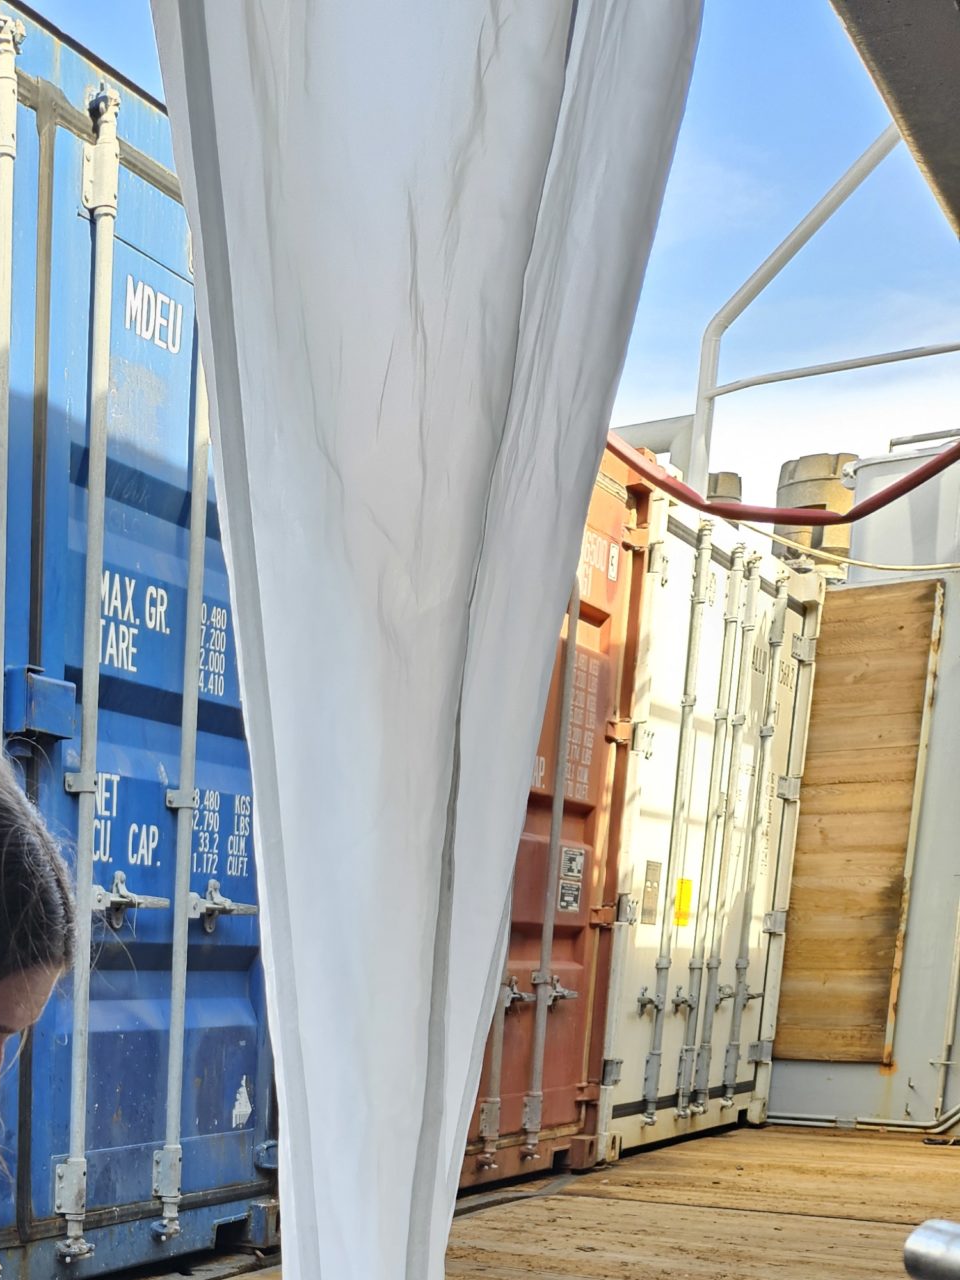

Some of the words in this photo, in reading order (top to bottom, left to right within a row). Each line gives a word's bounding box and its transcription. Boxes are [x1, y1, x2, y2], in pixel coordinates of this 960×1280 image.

[125, 274, 183, 354] MDEU
[145, 585, 170, 634] GR.
[201, 602, 227, 630] 0,480
[99, 618, 139, 672] TARE
[200, 625, 227, 652] 7,200
[193, 788, 220, 811] 8,480
[234, 794, 251, 815] KGS
[191, 810, 220, 832] 2,790
[234, 815, 250, 836] LBS
[93, 818, 113, 863] CU.
[128, 823, 160, 867] CAP.
[198, 832, 219, 853] 33.2
